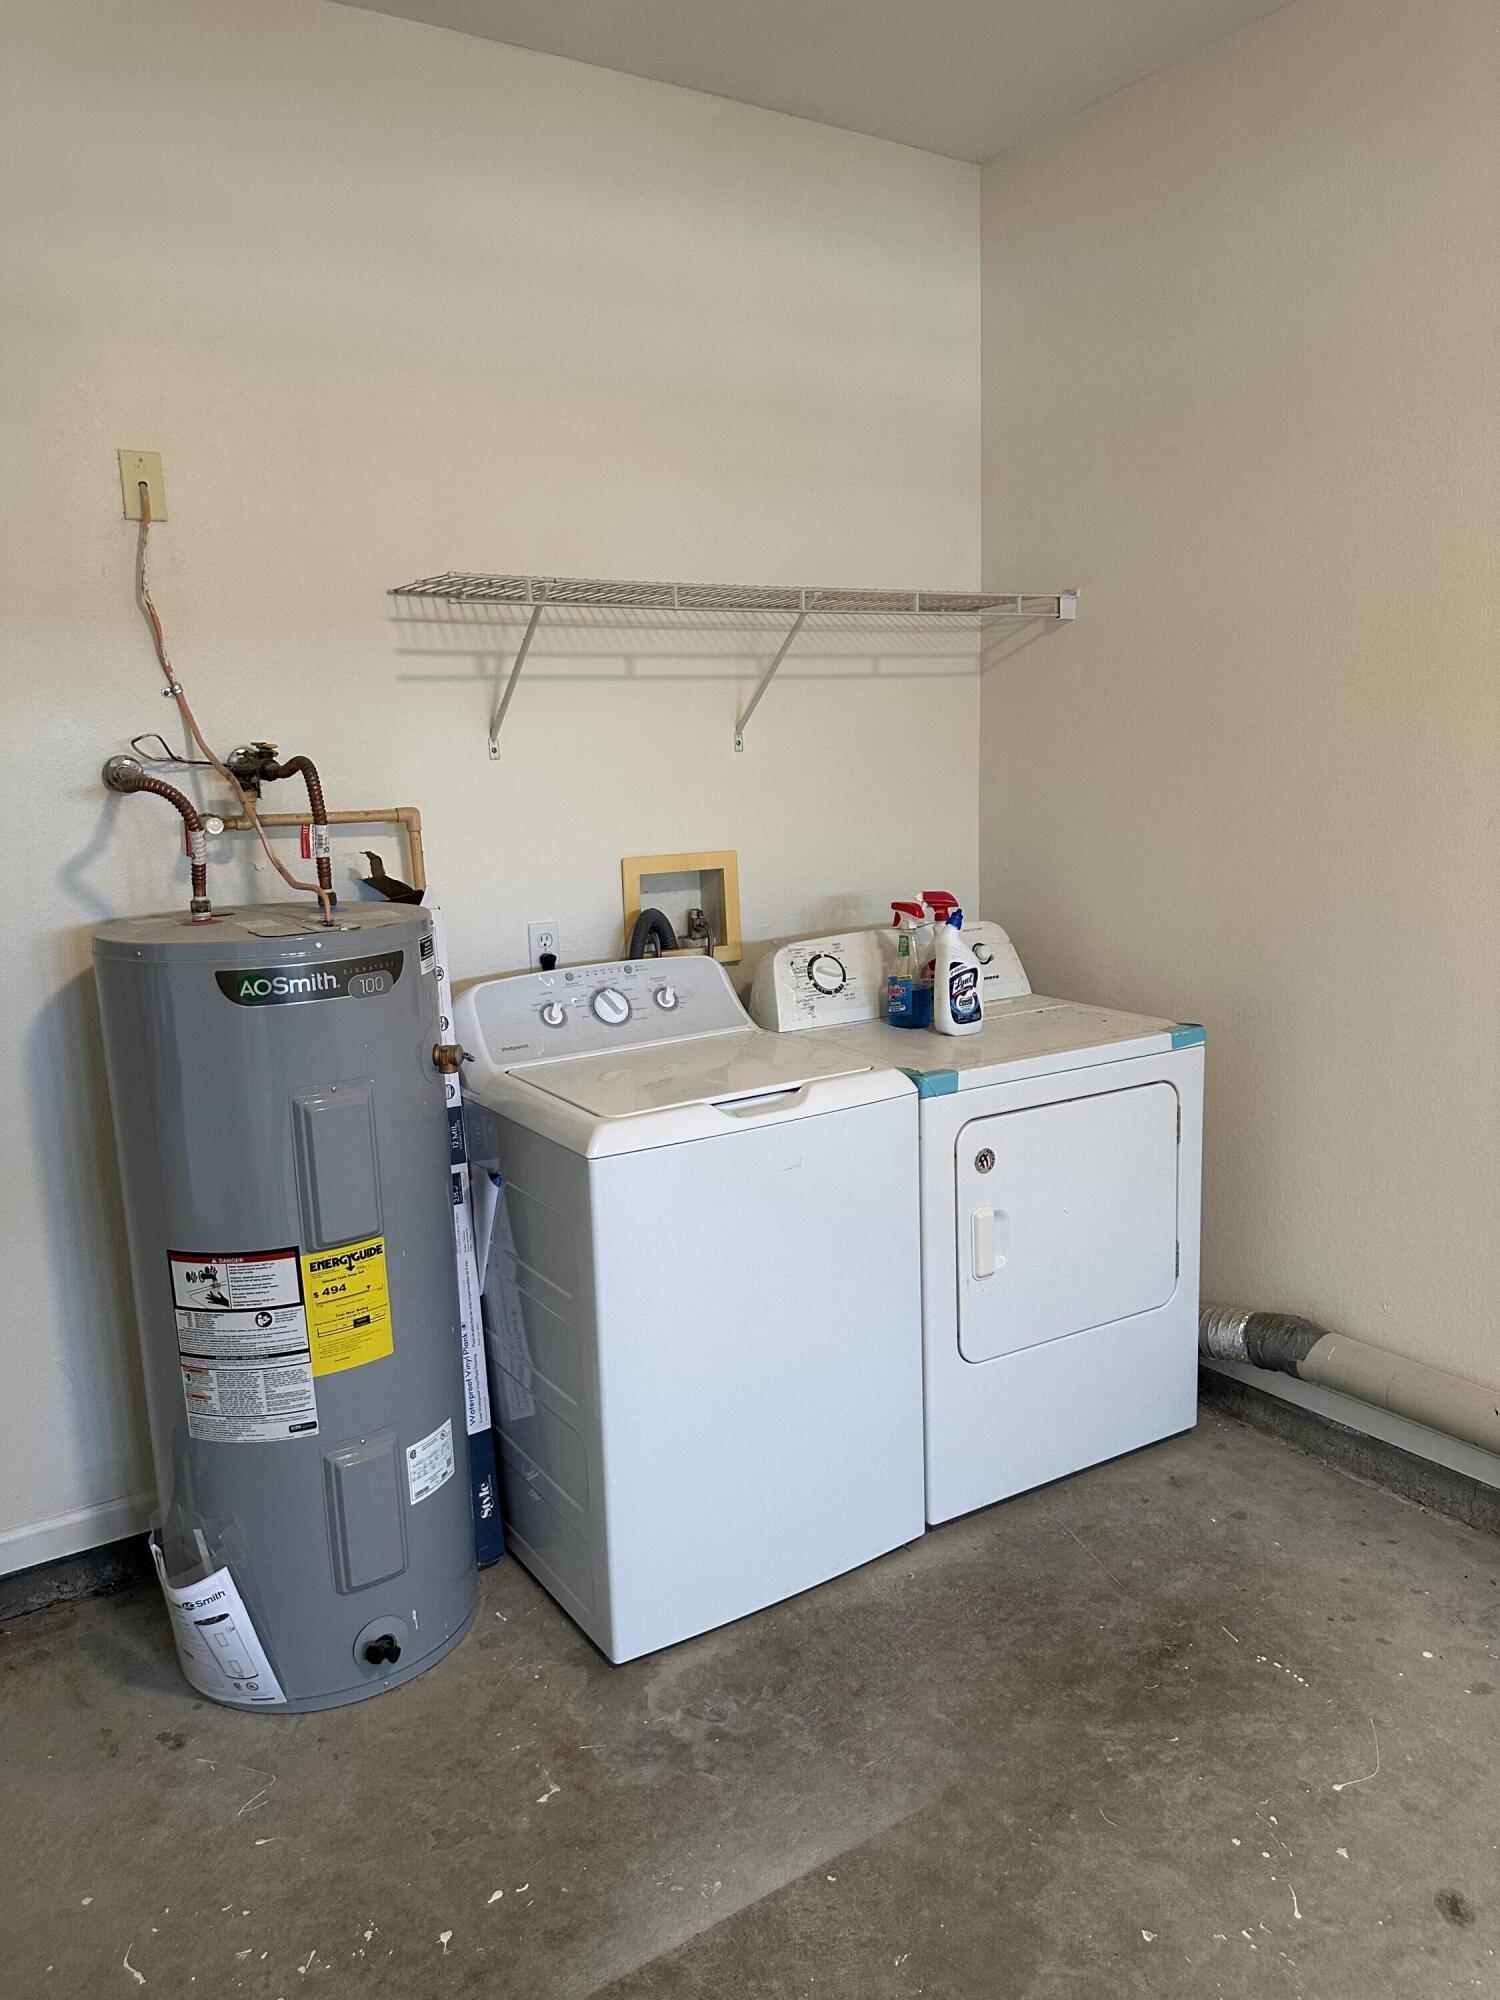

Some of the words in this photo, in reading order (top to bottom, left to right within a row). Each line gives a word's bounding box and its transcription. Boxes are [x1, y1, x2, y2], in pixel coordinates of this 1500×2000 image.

[359, 976, 384, 994] 100
[954, 973, 974, 991] Lysol
[309, 1244, 383, 1271] ENERGYGUIDE
[321, 1283, 347, 1297] 494
[461, 1332, 470, 1355] Plank
[463, 1356, 472, 1378] Vinyl
[466, 1379, 476, 1426] Waterproof
[478, 1482, 495, 1519] Style
[196, 1591, 226, 1608] Smith
